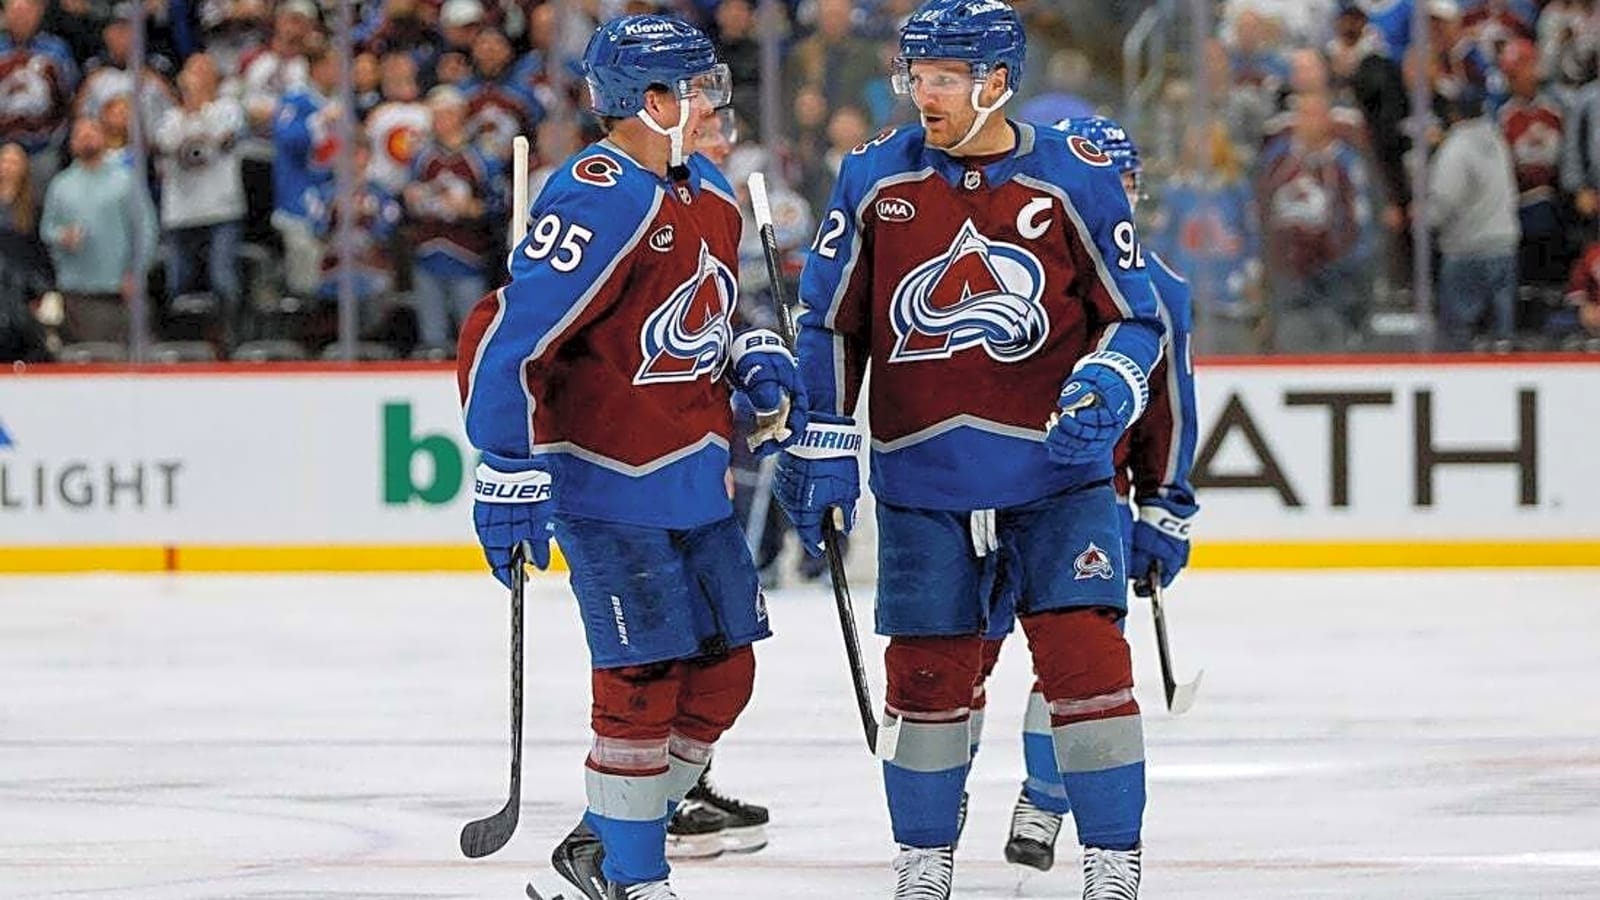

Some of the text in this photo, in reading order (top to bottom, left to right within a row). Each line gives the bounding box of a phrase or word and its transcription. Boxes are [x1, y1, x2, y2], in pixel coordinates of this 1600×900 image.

[879, 202, 910, 217] IMA
[524, 214, 593, 272] 95
[810, 210, 846, 259] 2
[1, 462, 182, 507] LIGHT
